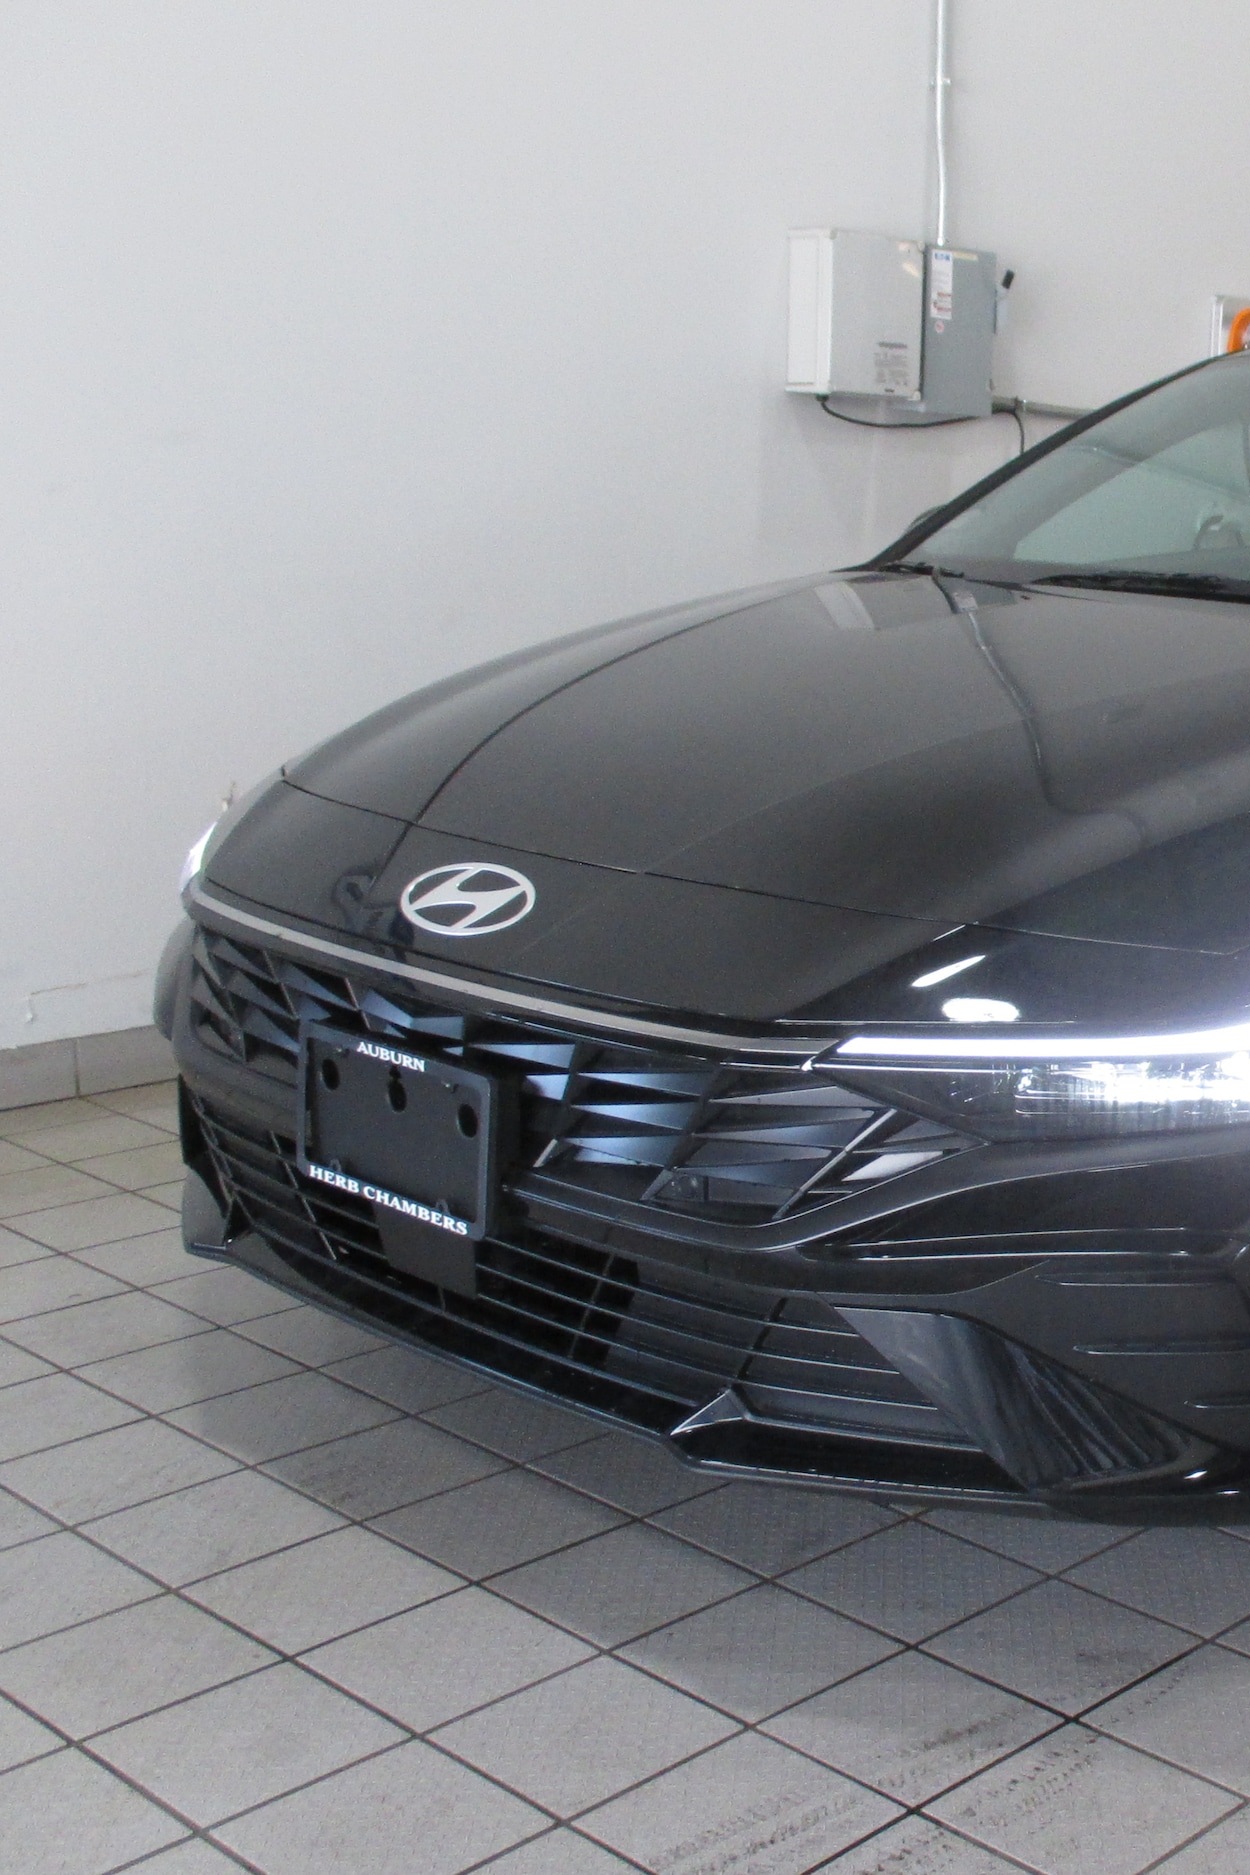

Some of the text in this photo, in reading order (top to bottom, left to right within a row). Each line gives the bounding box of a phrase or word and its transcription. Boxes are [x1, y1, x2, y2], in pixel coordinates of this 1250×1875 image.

[357, 1041, 425, 1073] AUBURN
[309, 1164, 468, 1236] HERB CHAMBERS
